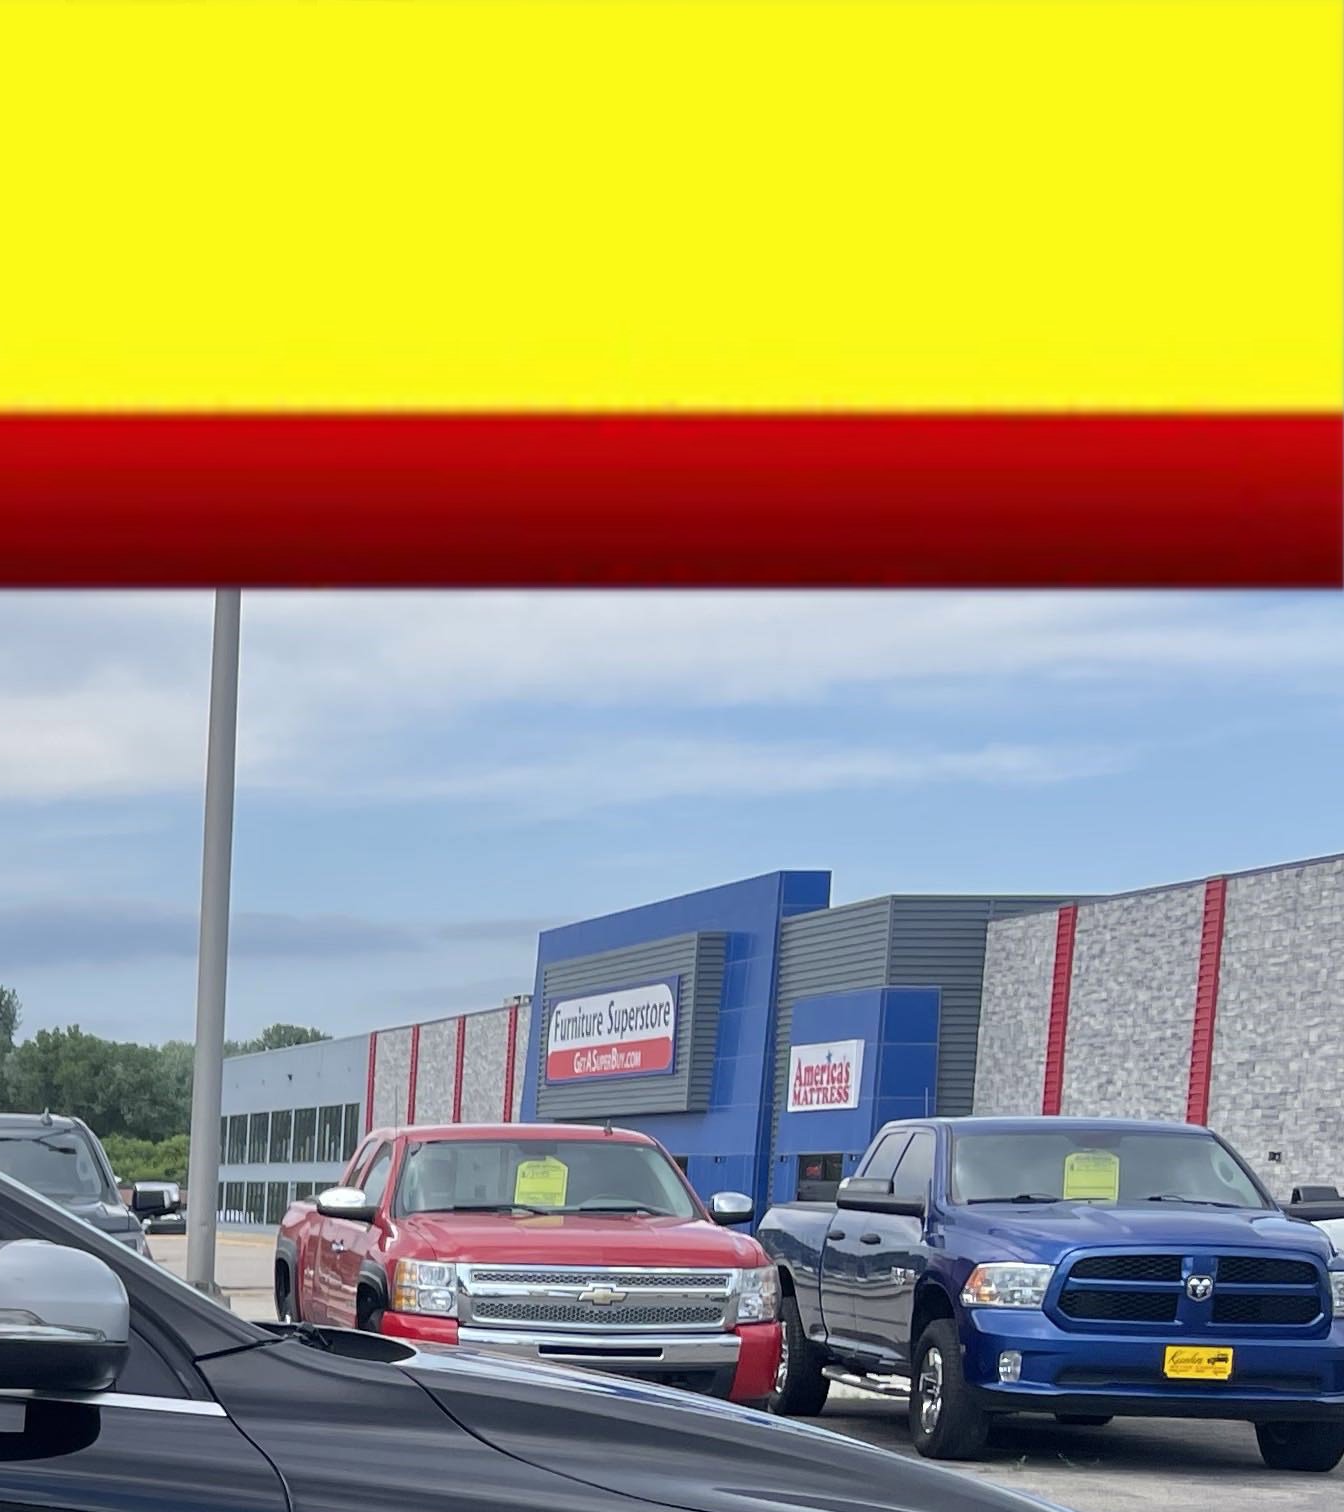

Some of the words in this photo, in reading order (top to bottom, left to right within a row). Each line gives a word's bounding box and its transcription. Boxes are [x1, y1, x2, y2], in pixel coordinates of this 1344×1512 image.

[554, 1005, 603, 1042] Furniture
[607, 999, 670, 1039] Superstore
[792, 1085, 850, 1107] MATTRESS
